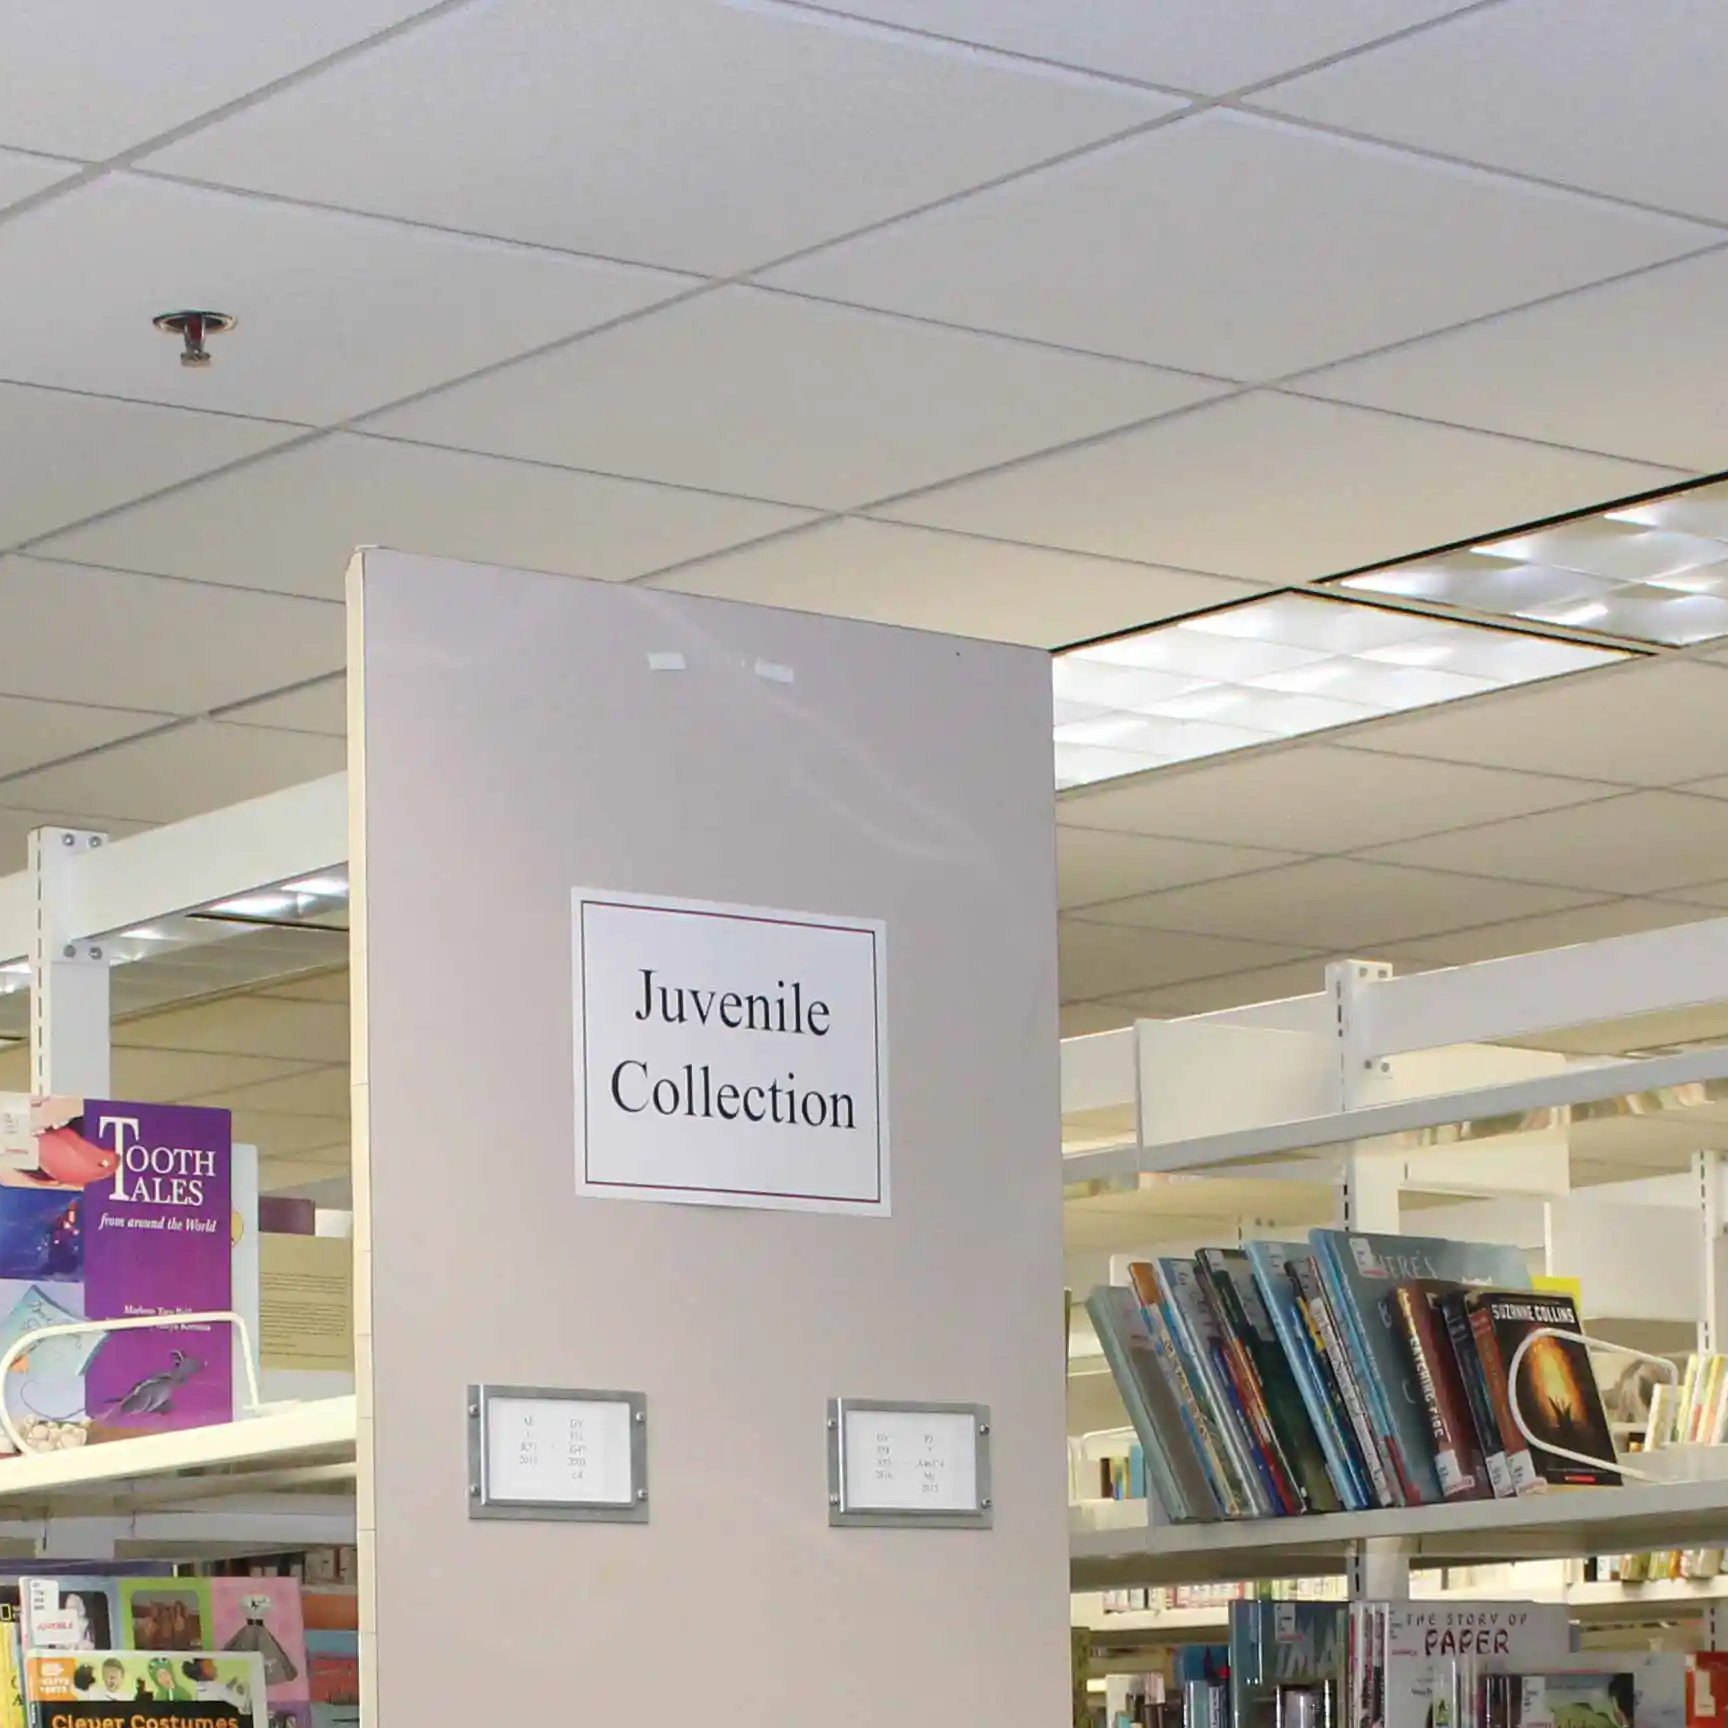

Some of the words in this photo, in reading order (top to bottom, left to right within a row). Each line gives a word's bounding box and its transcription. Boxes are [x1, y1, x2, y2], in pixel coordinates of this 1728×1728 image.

[635, 969, 831, 1037] Juvenile
[610, 1058, 856, 1130] Collection
[98, 1213, 125, 1231] from
[127, 1217, 165, 1230] around
[167, 1216, 183, 1231] the
[185, 1217, 217, 1233] World
[1492, 1304, 1533, 1321] SUZANNE
[1535, 1306, 1575, 1323] COLLINS
[1407, 1613, 1436, 1626] THE
[1447, 1613, 1499, 1626] STORY
[1425, 1629, 1510, 1656] PAPER
